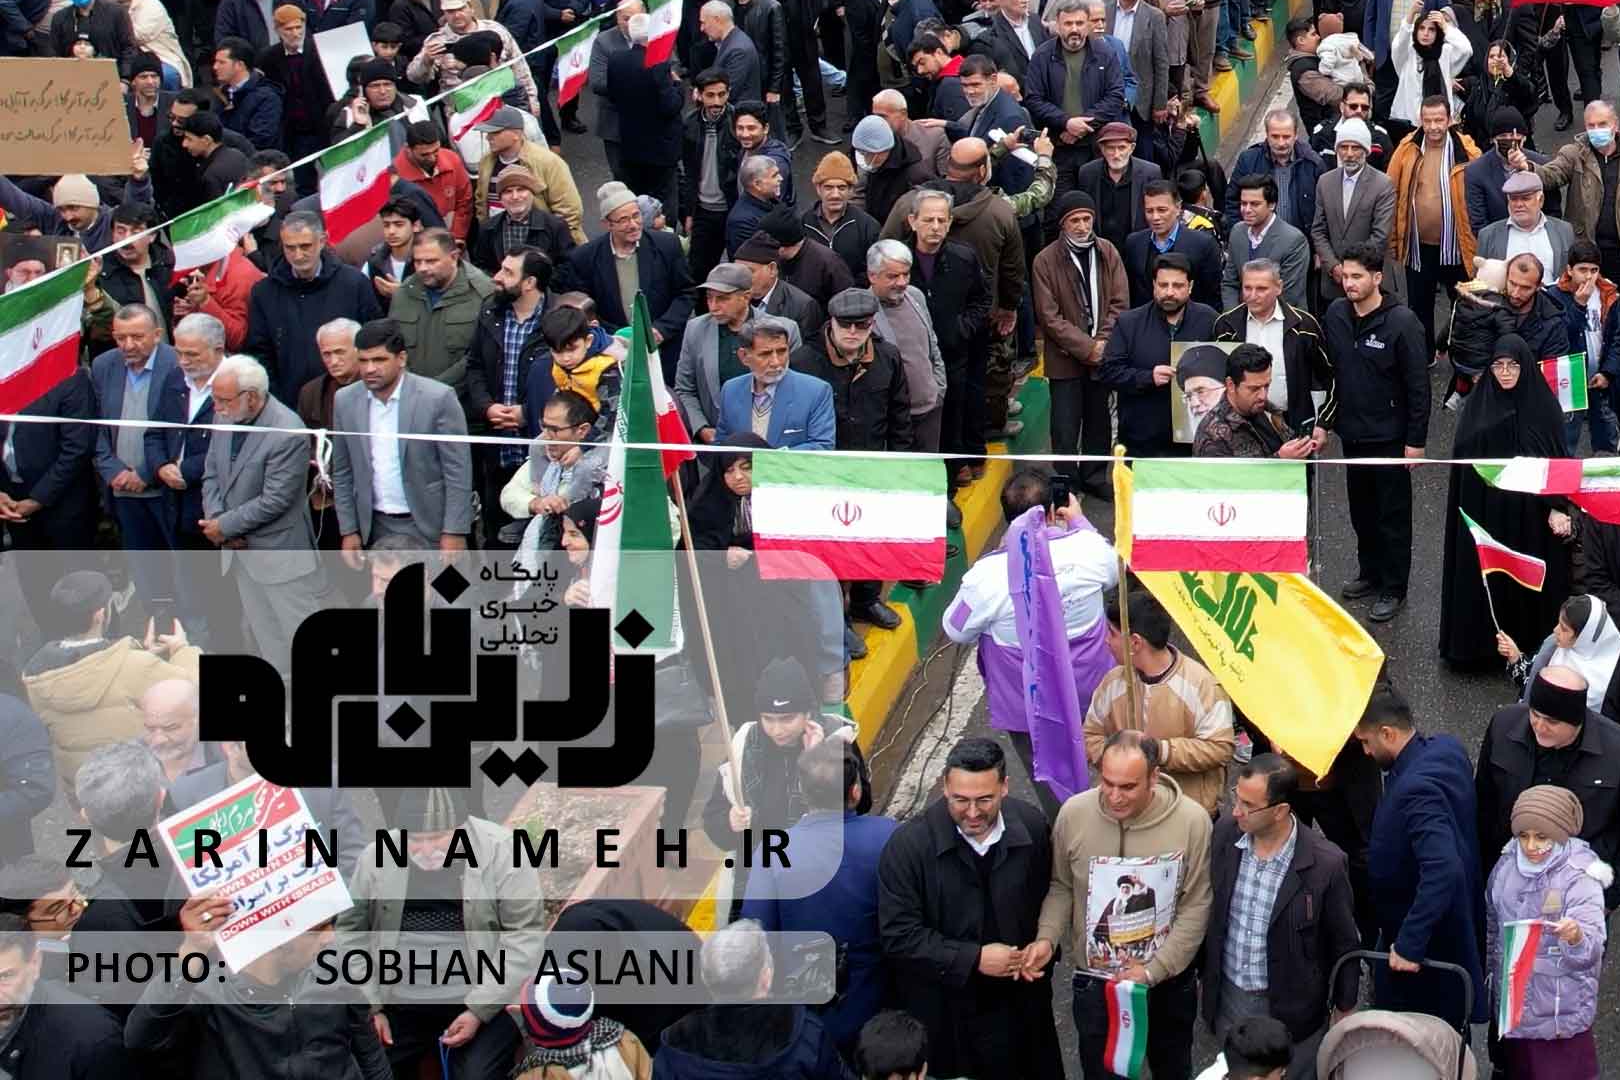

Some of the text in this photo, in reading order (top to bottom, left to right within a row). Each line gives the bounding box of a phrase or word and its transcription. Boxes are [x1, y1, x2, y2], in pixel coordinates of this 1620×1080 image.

[221, 873, 335, 938] DOWN WITH ISRAEL
